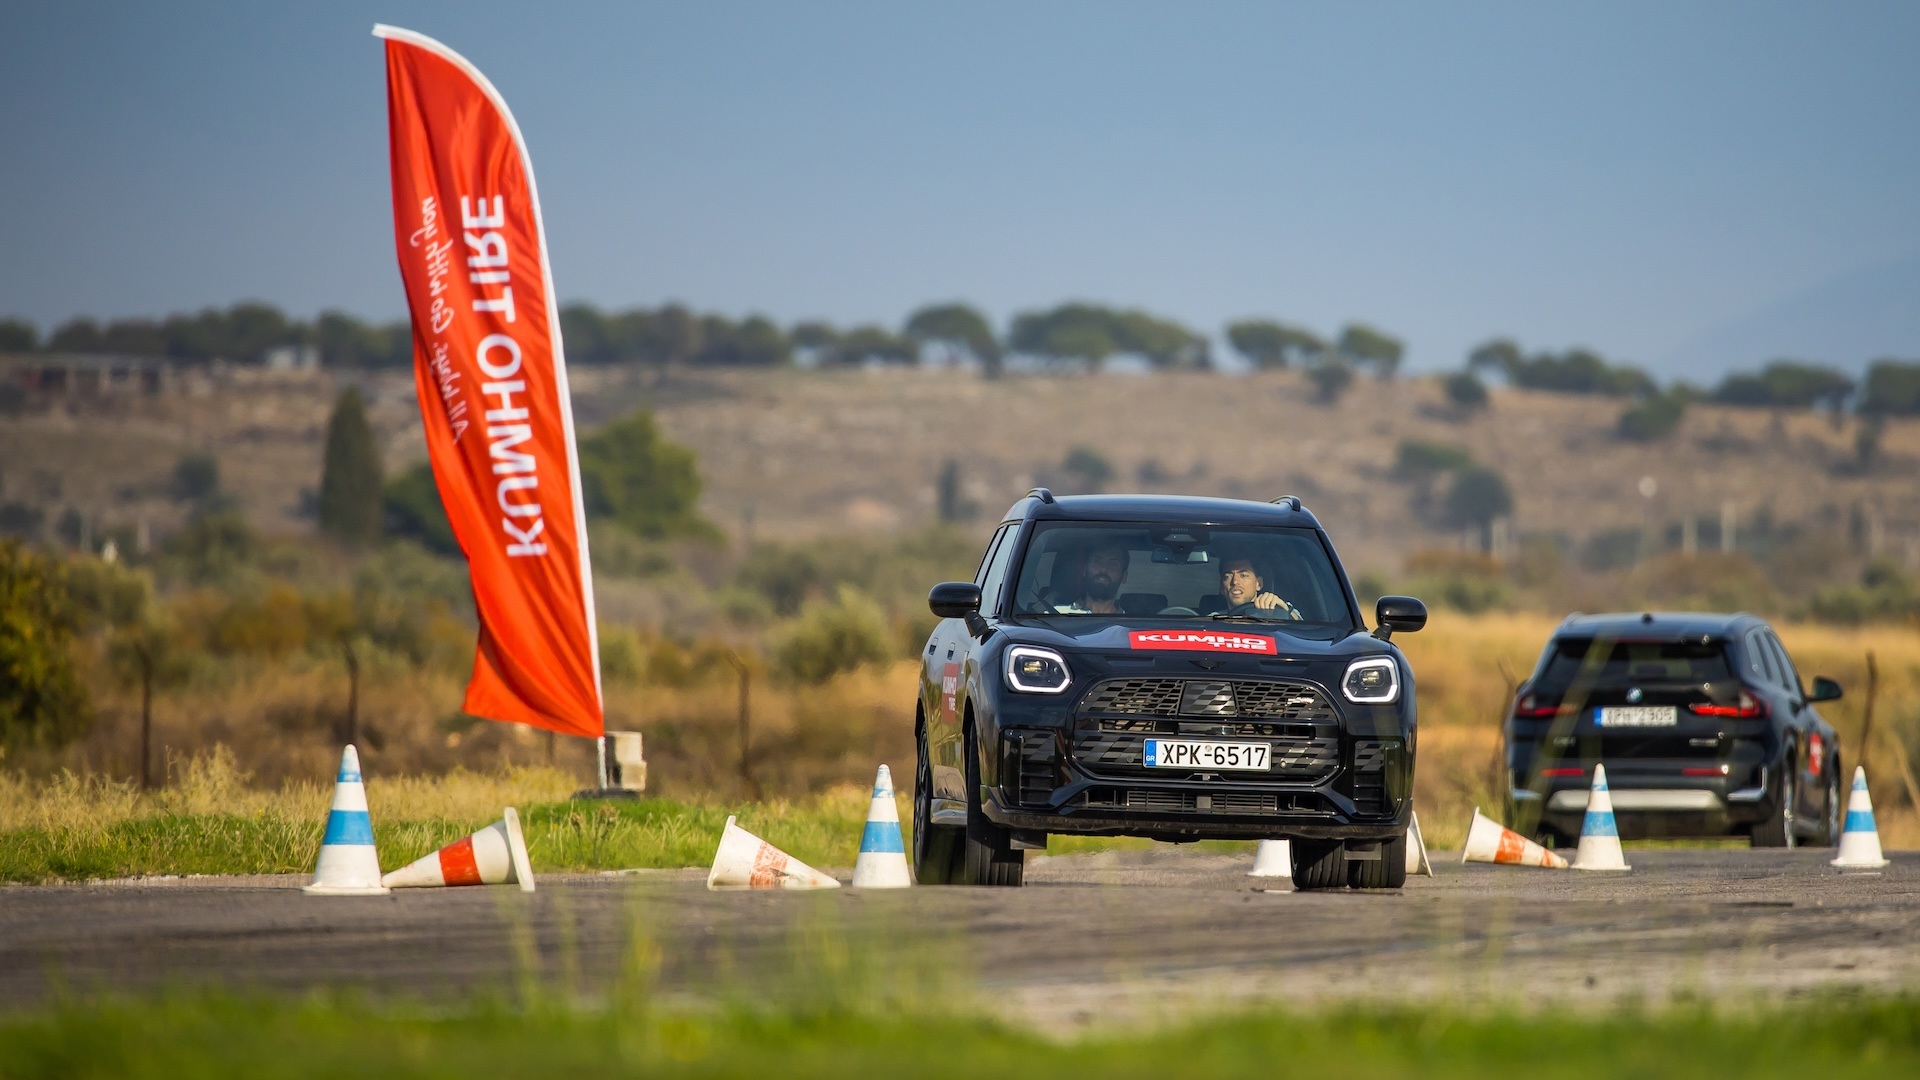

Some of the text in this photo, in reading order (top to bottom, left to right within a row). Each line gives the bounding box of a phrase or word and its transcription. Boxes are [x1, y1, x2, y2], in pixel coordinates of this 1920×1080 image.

[1137, 634, 1268, 646] KUMHO
[1207, 641, 1268, 651] TIRE
[1162, 743, 1267, 768] XPK-6517
